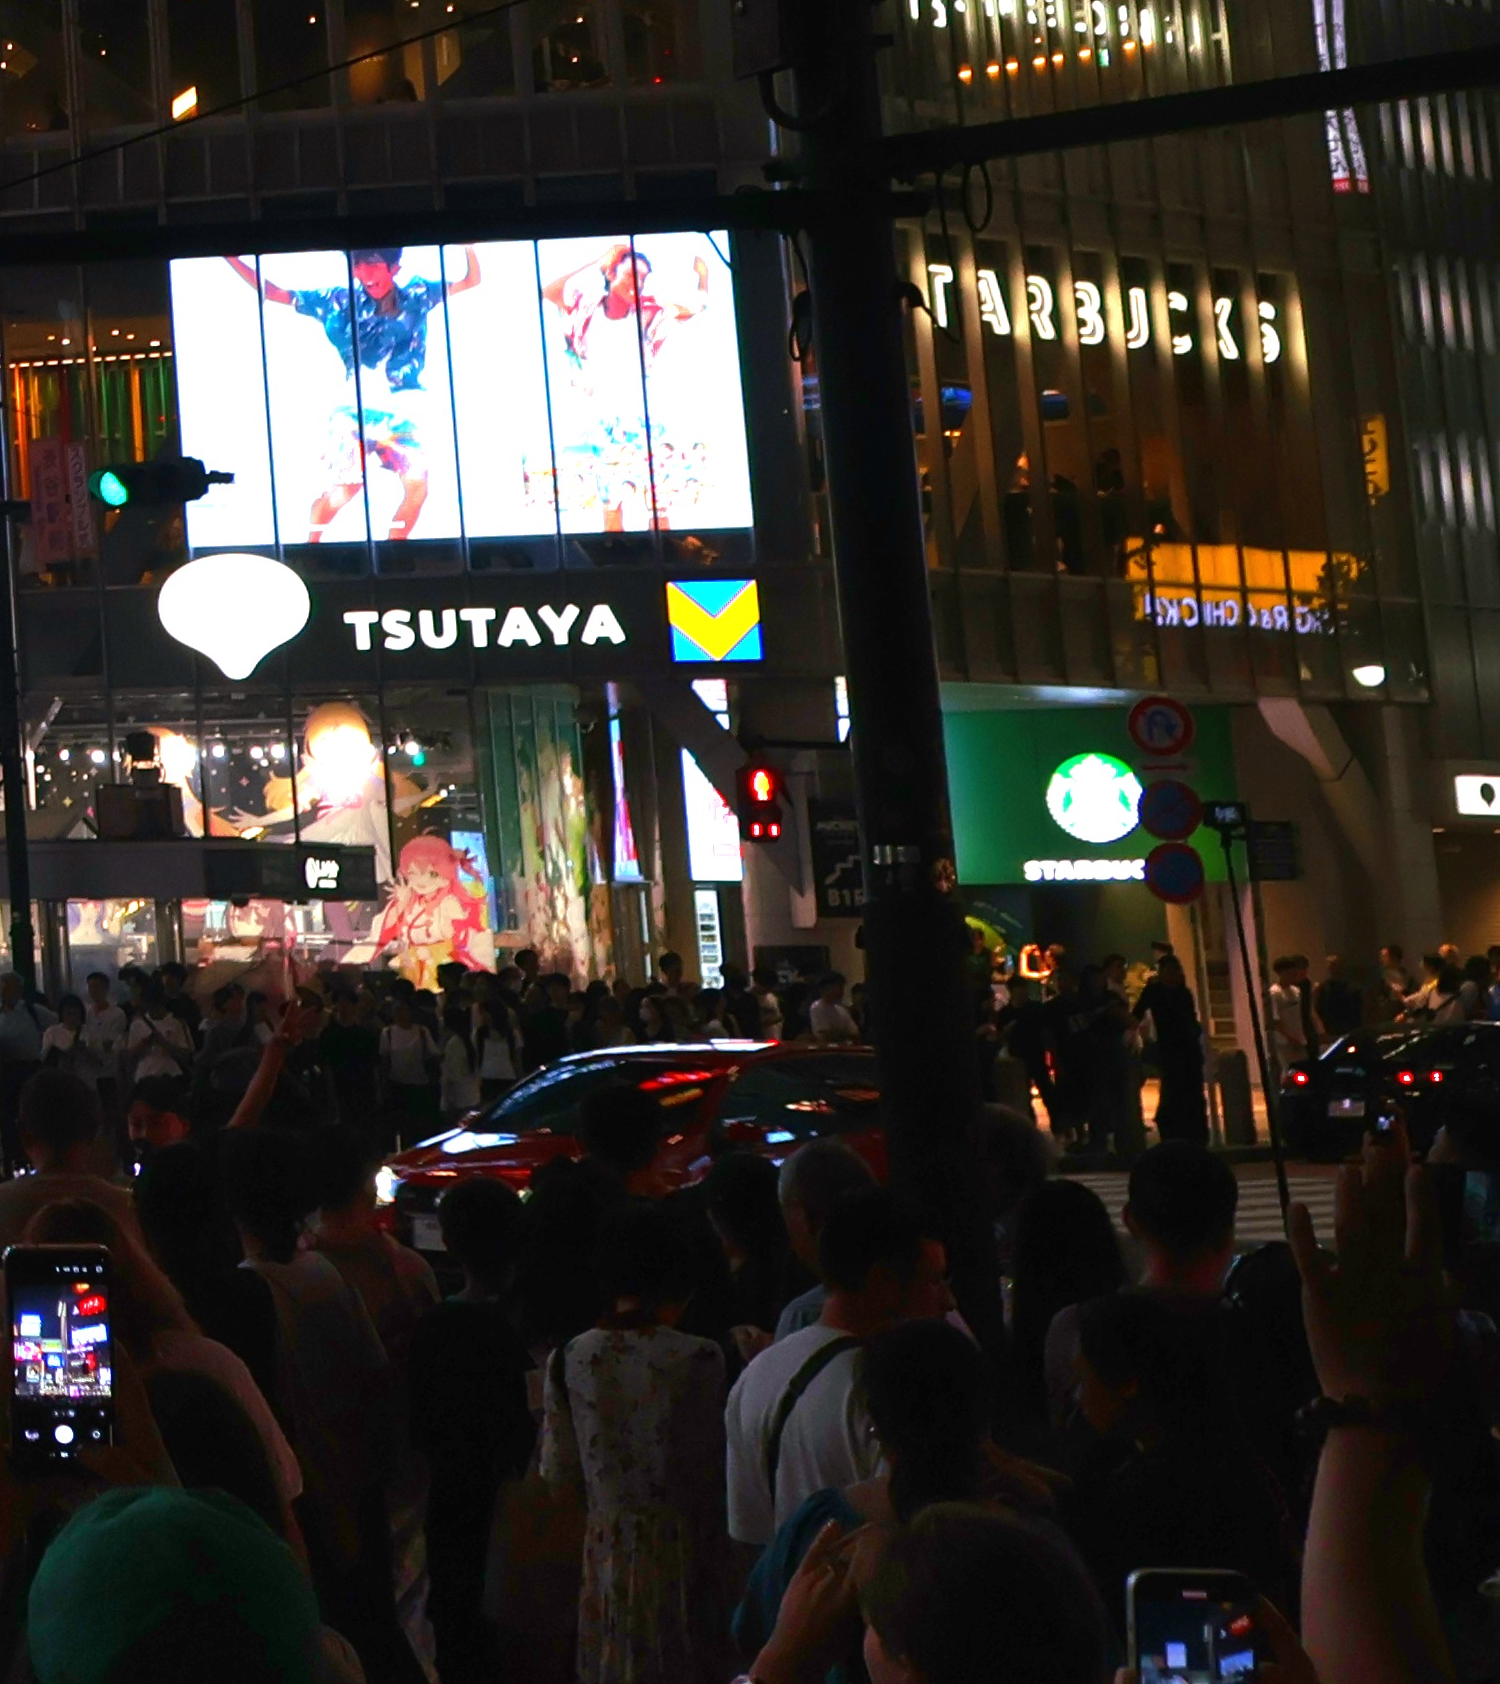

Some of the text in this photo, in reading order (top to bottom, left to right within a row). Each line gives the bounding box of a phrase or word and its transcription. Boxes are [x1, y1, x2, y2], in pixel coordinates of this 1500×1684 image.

[928, 263, 1282, 364] TARBUCKS
[343, 603, 627, 653] TSUTAYA
[1023, 857, 1147, 882] STARBUC
